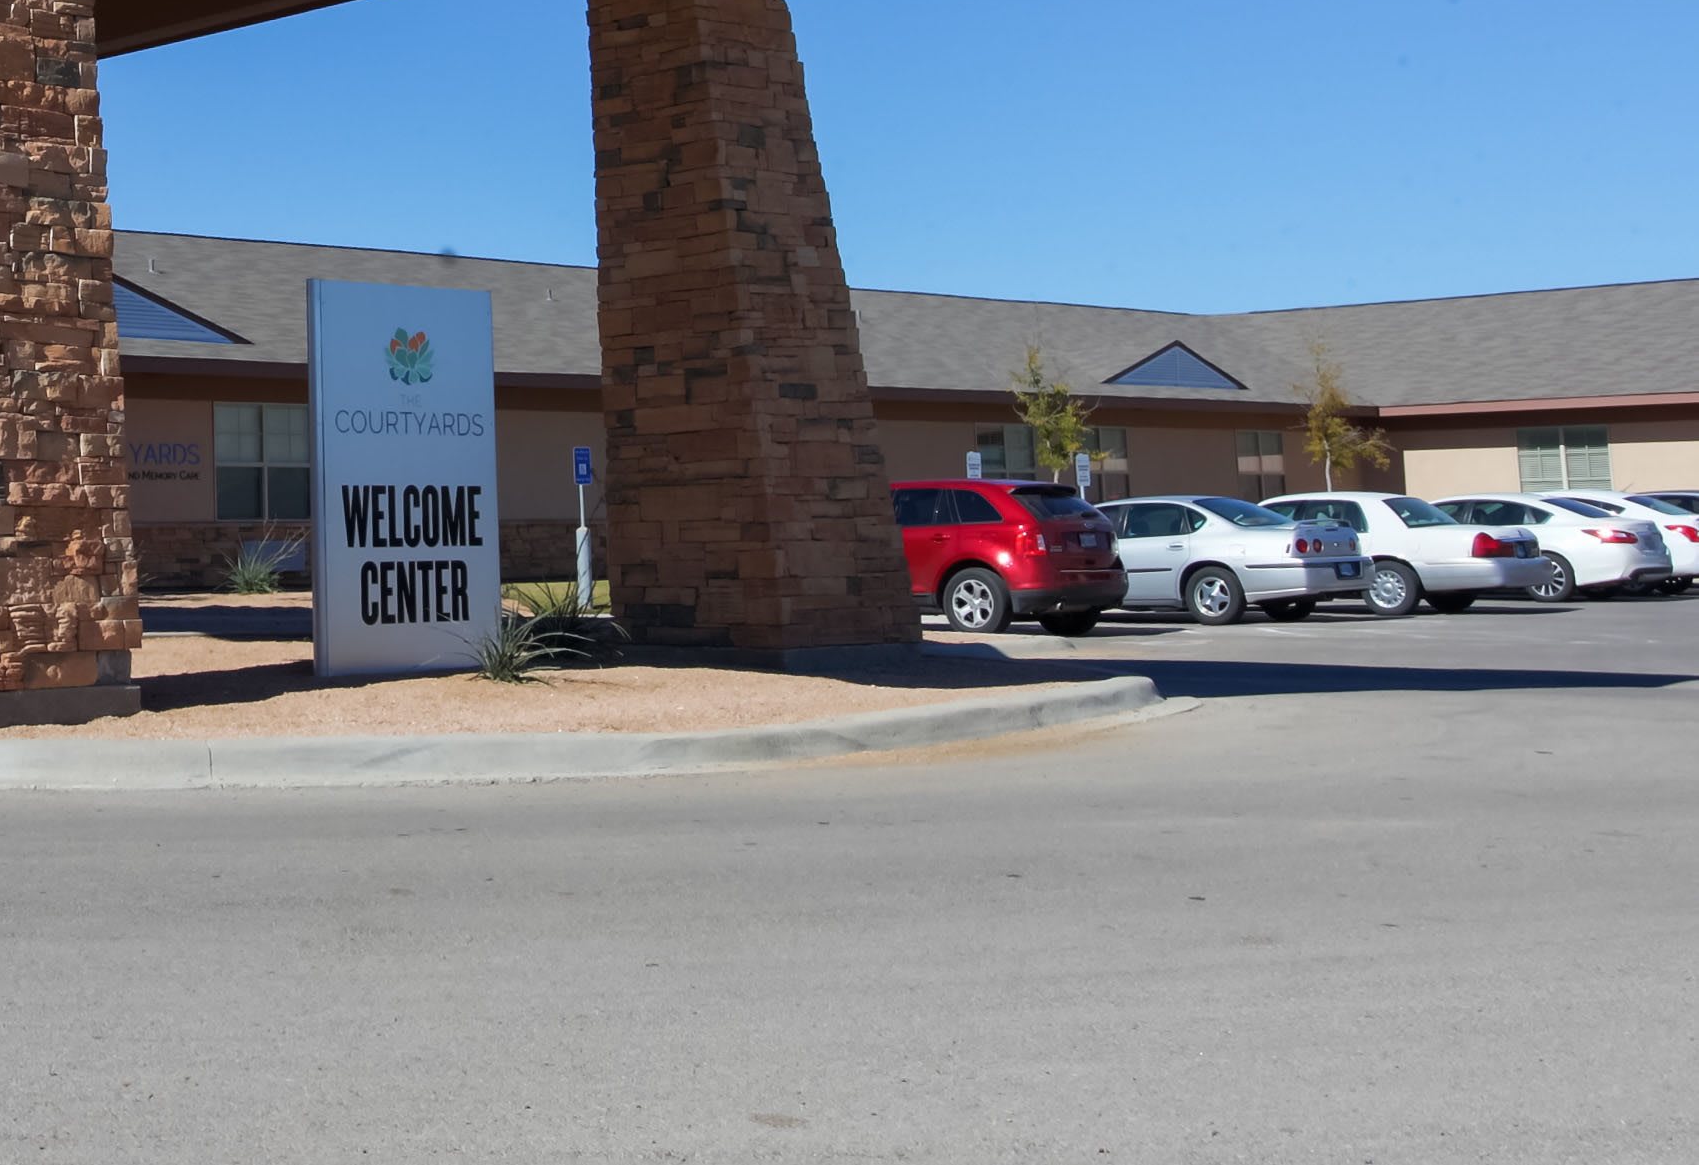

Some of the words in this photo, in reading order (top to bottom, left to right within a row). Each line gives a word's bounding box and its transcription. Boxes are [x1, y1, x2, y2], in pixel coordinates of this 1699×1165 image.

[399, 394, 422, 406] THE
[335, 410, 484, 437] COURTYARDS
[128, 443, 201, 466] YARDS
[342, 485, 483, 548] WELCOME
[361, 560, 469, 626] CENTER
